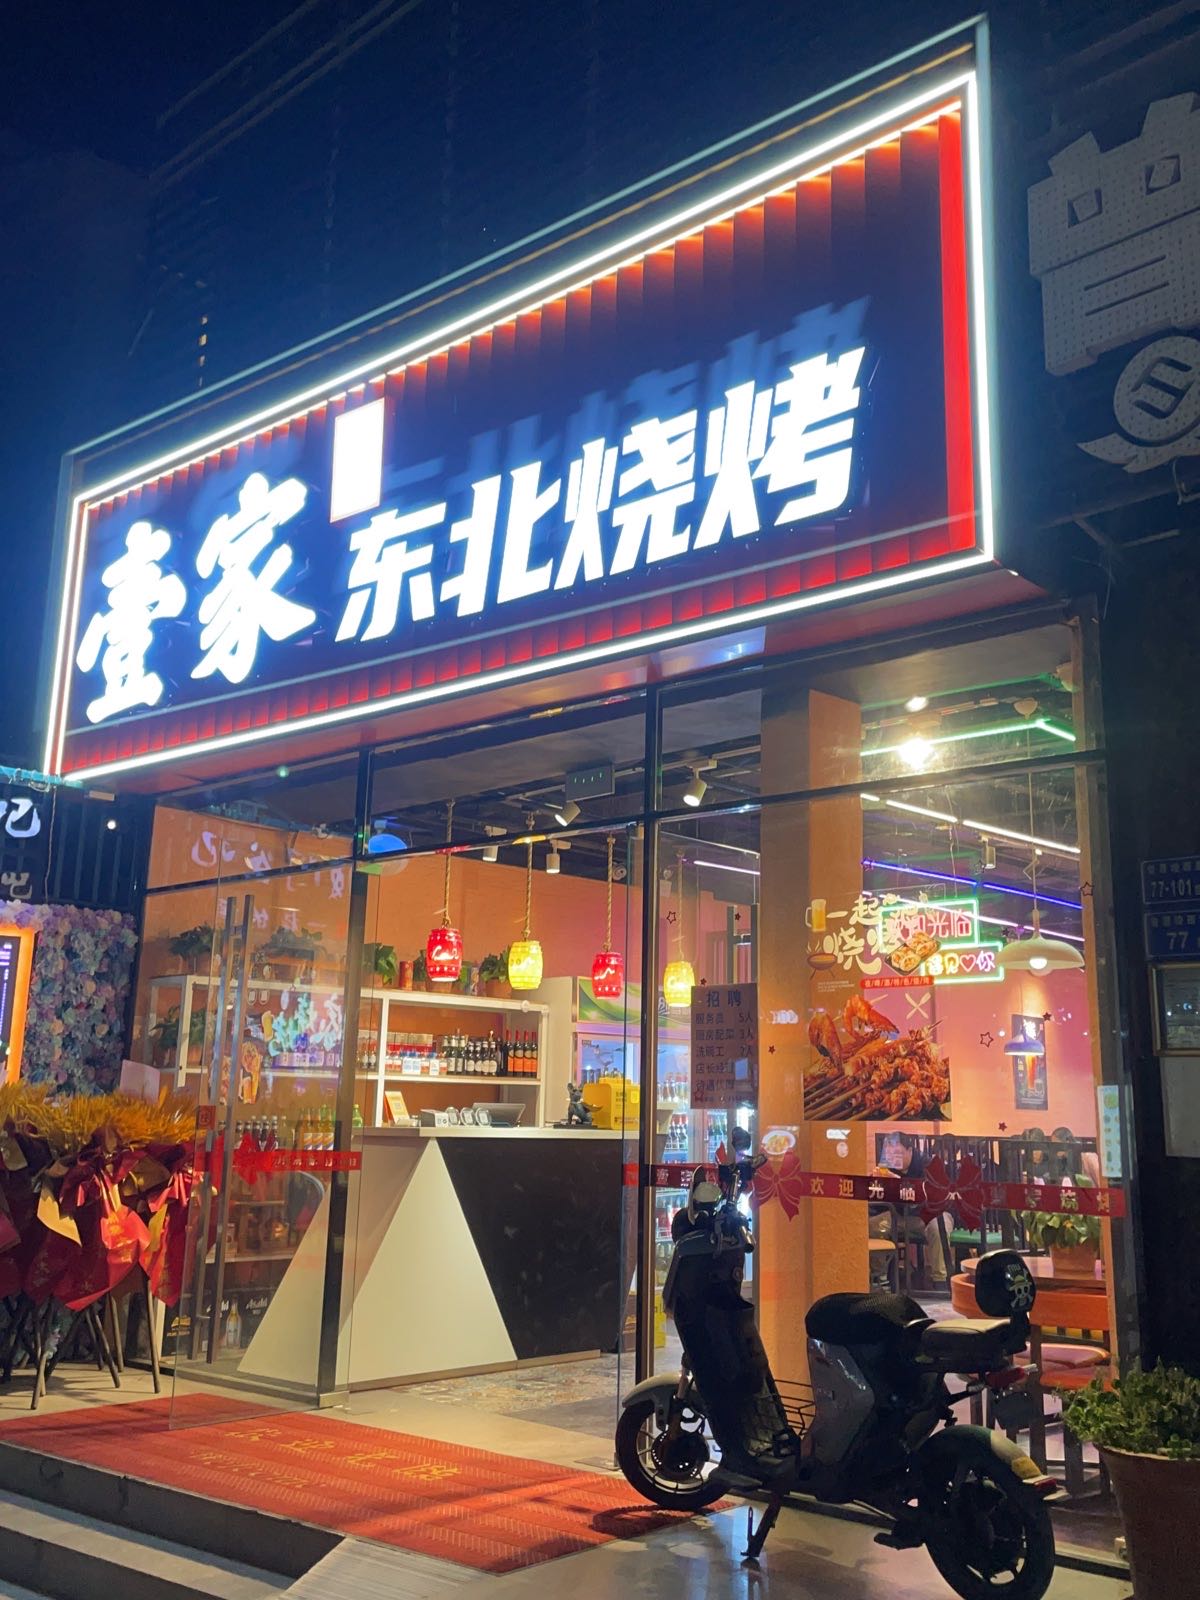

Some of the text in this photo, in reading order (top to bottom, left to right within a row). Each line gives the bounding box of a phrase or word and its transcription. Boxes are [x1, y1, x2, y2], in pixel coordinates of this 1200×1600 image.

[76, 346, 865, 723] 壹家 东北烧烤
[706, 989, 742, 1008] 招聘
[810, 1178, 917, 1202] 欢迎光临
